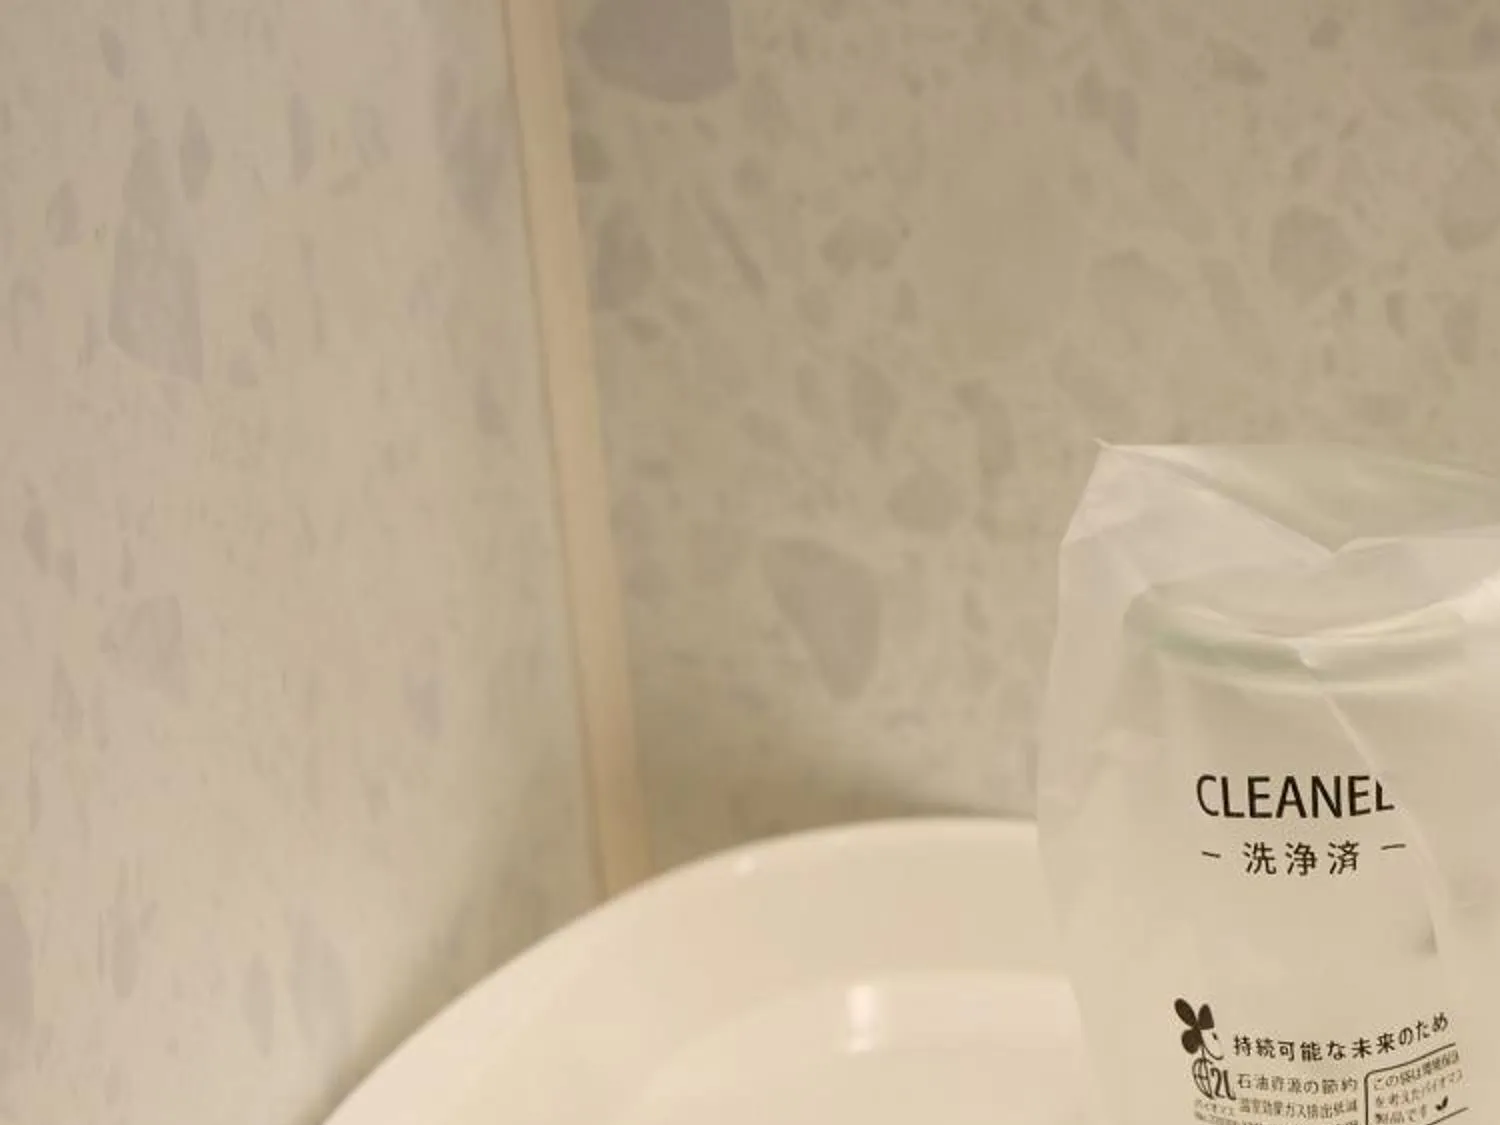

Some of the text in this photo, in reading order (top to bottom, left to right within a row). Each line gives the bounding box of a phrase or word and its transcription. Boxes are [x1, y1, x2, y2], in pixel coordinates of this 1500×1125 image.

[1242, 839, 1361, 877] 洗浄済
[1232, 1011, 1450, 1063] 持続可能な未来のため
